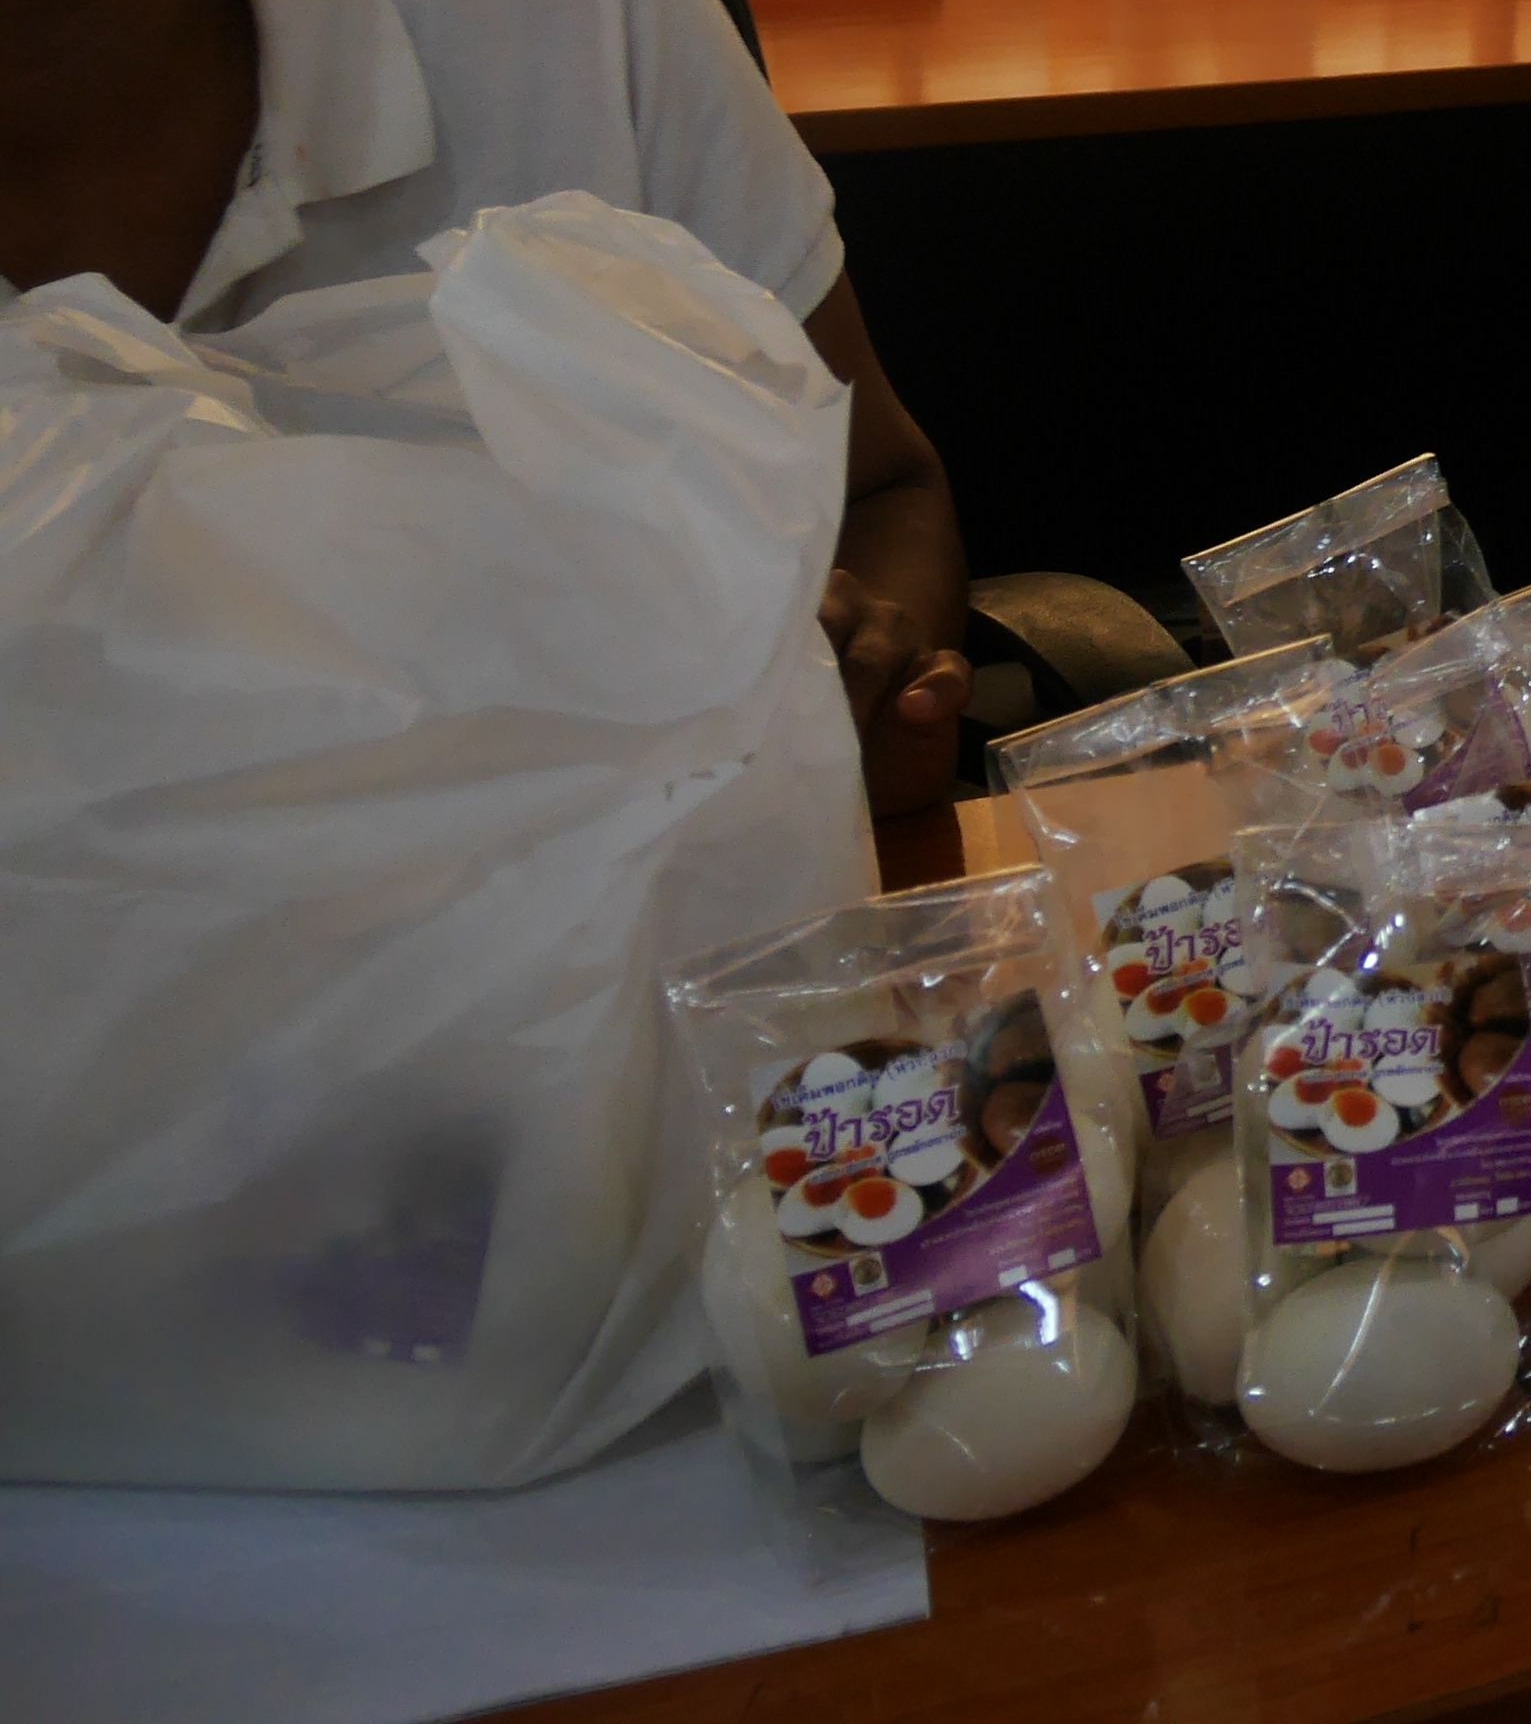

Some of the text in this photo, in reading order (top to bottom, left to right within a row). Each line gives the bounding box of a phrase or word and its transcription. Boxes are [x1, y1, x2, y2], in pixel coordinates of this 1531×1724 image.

[1145, 918, 1243, 973] ป้ารอ
[1302, 1018, 1442, 1065] ป้ารอด
[803, 1085, 960, 1160] ป้ารอด
